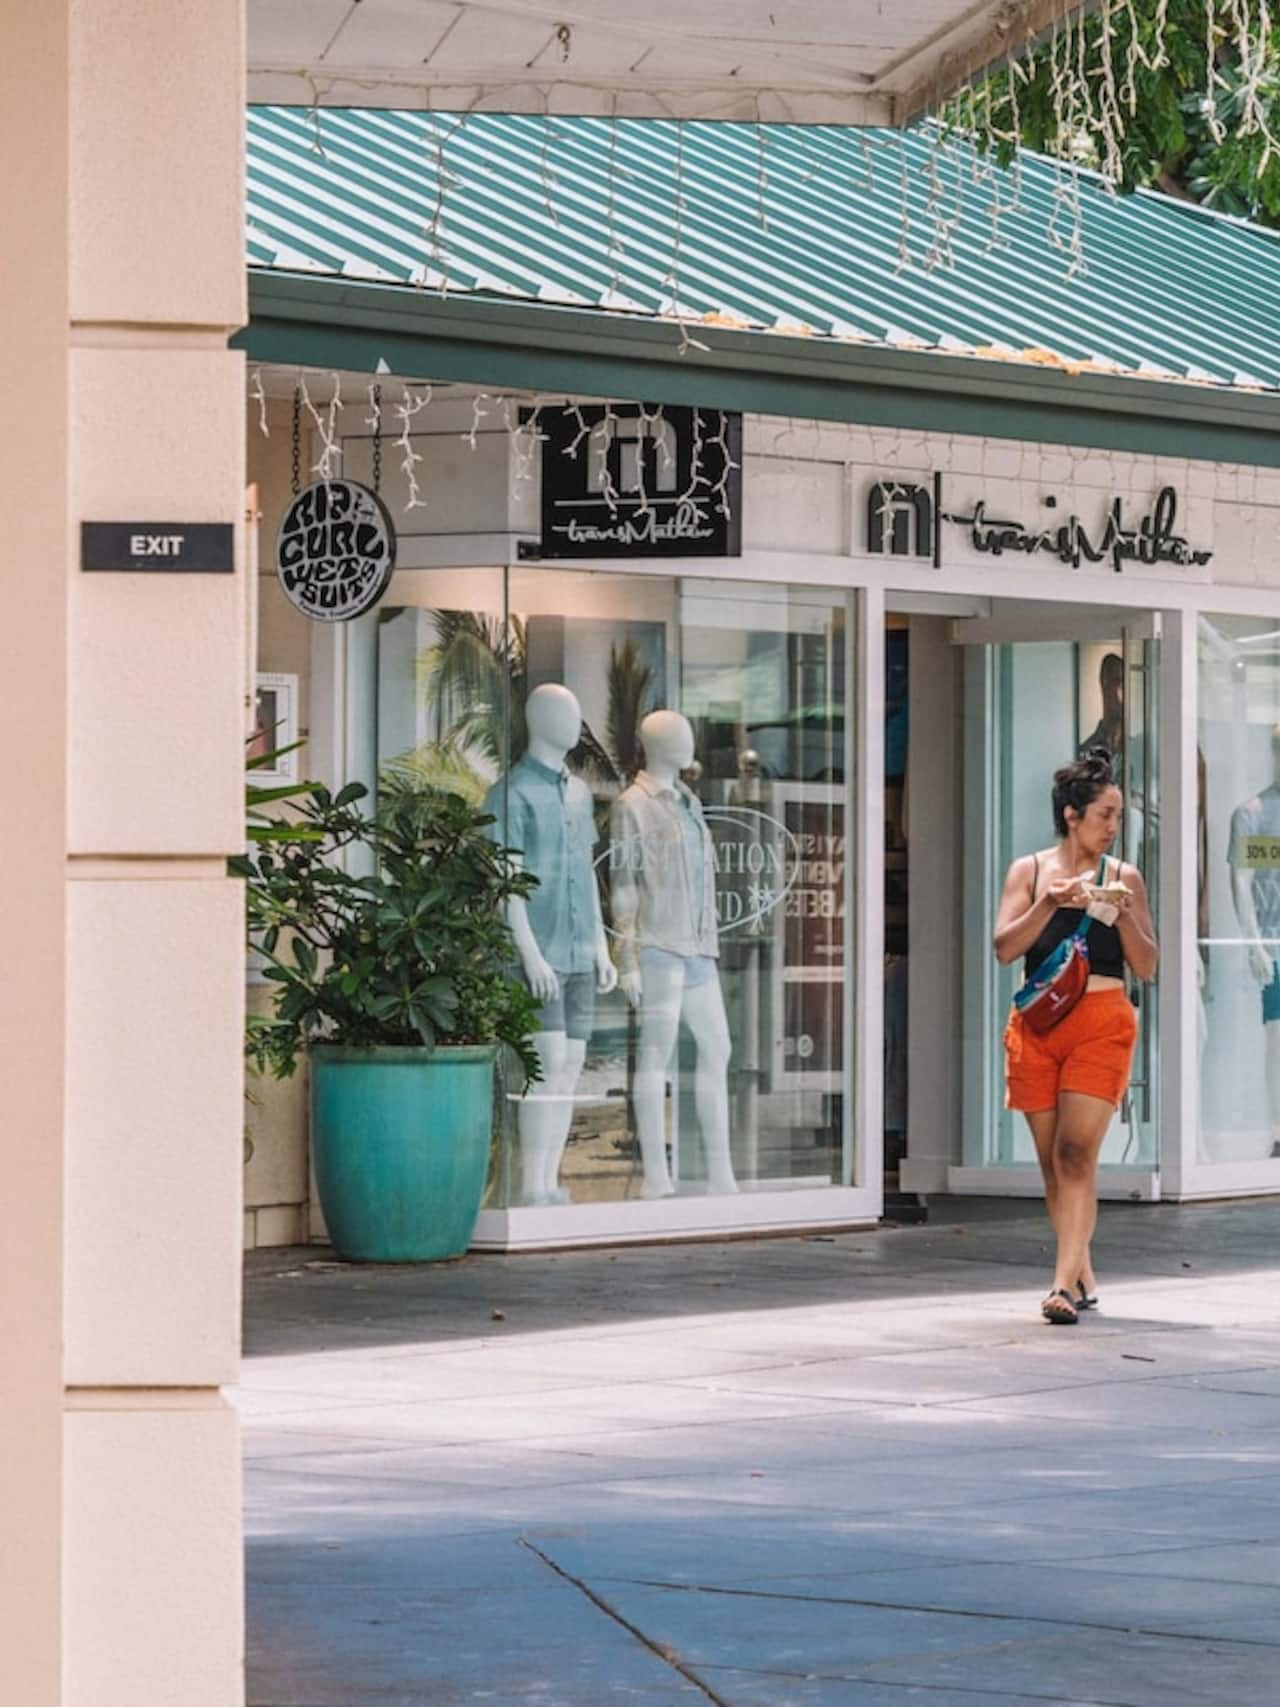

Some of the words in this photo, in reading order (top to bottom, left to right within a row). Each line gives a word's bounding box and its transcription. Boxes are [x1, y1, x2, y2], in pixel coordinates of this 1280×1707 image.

[283, 484, 350, 534] RIP
[130, 535, 184, 556] EXIT
[280, 522, 385, 568] CURL
